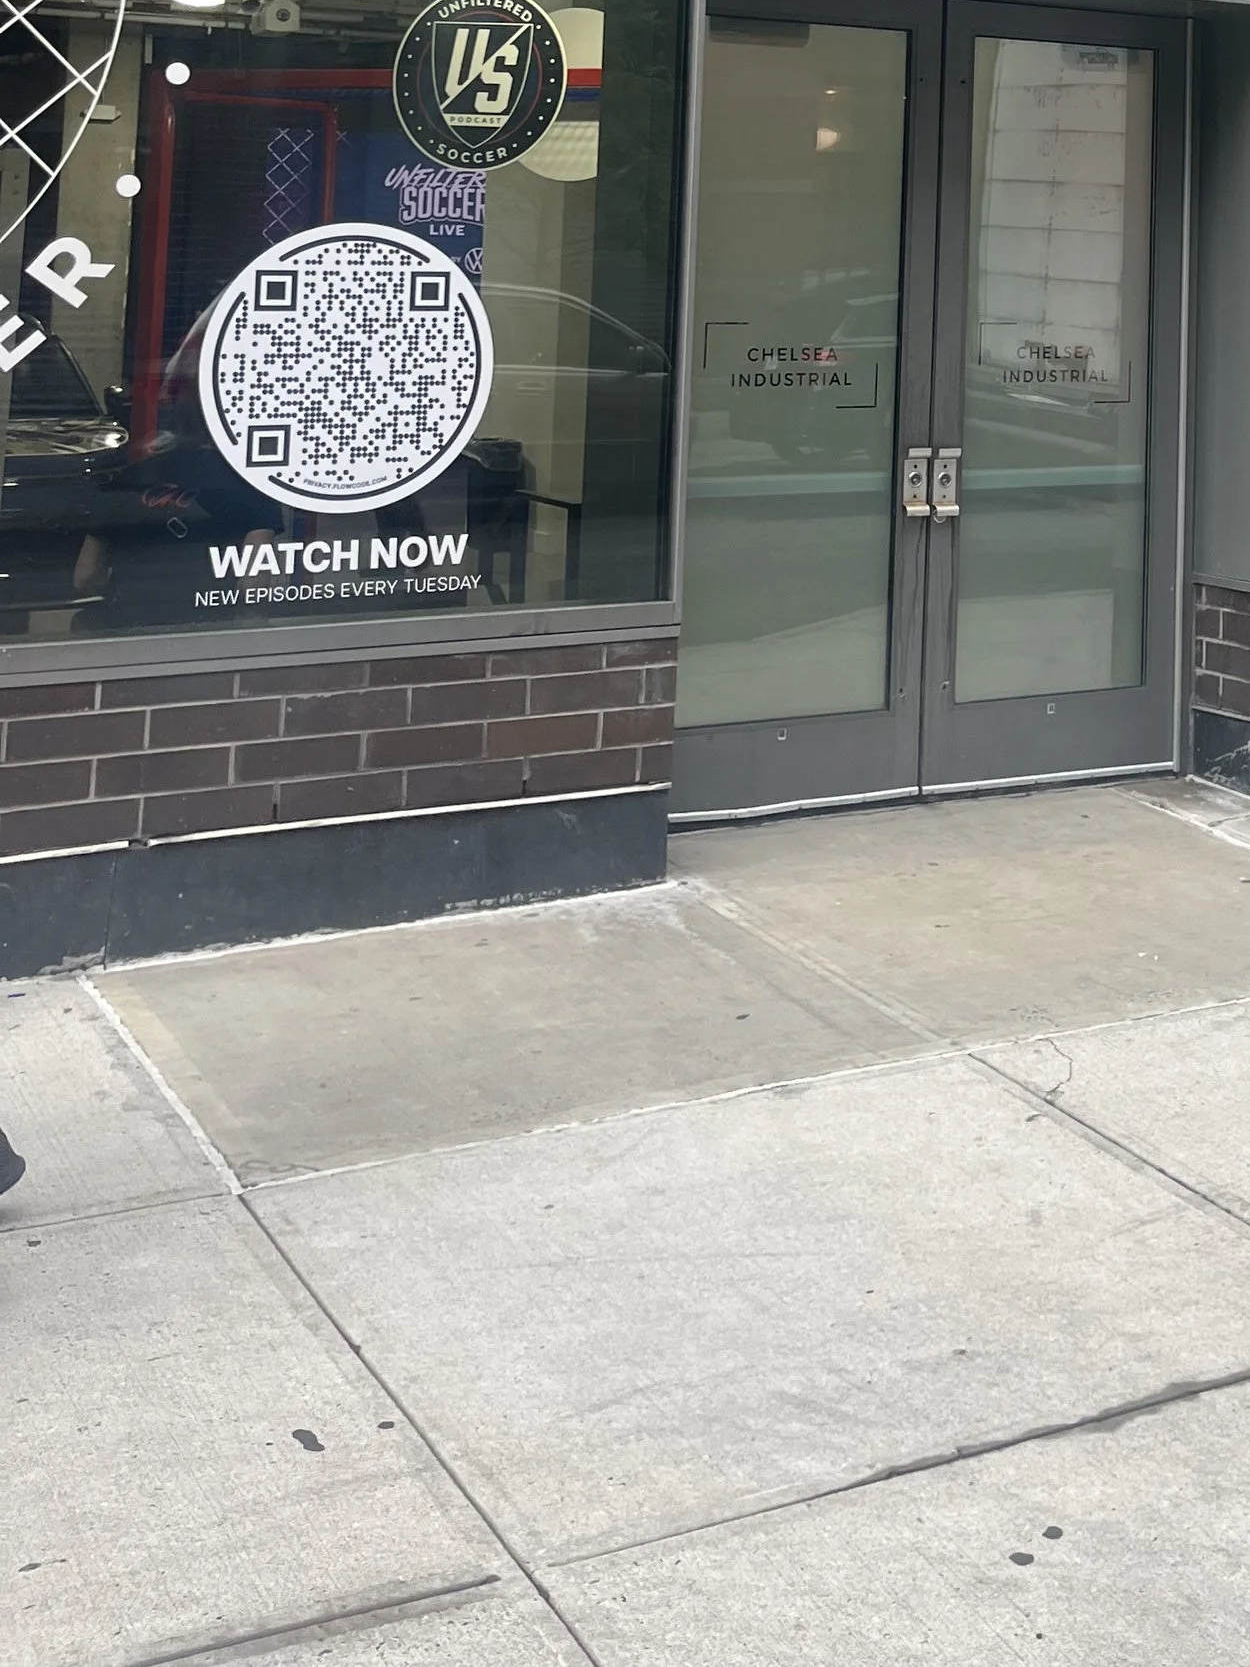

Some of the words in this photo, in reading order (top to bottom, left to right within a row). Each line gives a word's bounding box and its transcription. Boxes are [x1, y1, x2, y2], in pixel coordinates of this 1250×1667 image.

[450, 116, 502, 124] PODCAST
[436, 143, 508, 164] SOCCER
[429, 224, 465, 236] LIVE
[747, 347, 837, 362] CHELSEA
[1017, 346, 1096, 359] CHELSEA
[731, 372, 852, 387] INDUSTRIAL
[1003, 369, 1108, 383] INDUSTRIAL
[209, 539, 360, 579] WATCH
[369, 533, 469, 569] NOW
[195, 590, 240, 607] NEW
[245, 583, 335, 603] EPISODES
[340, 579, 398, 597] EVERY
[403, 574, 482, 593] TUESDAY
